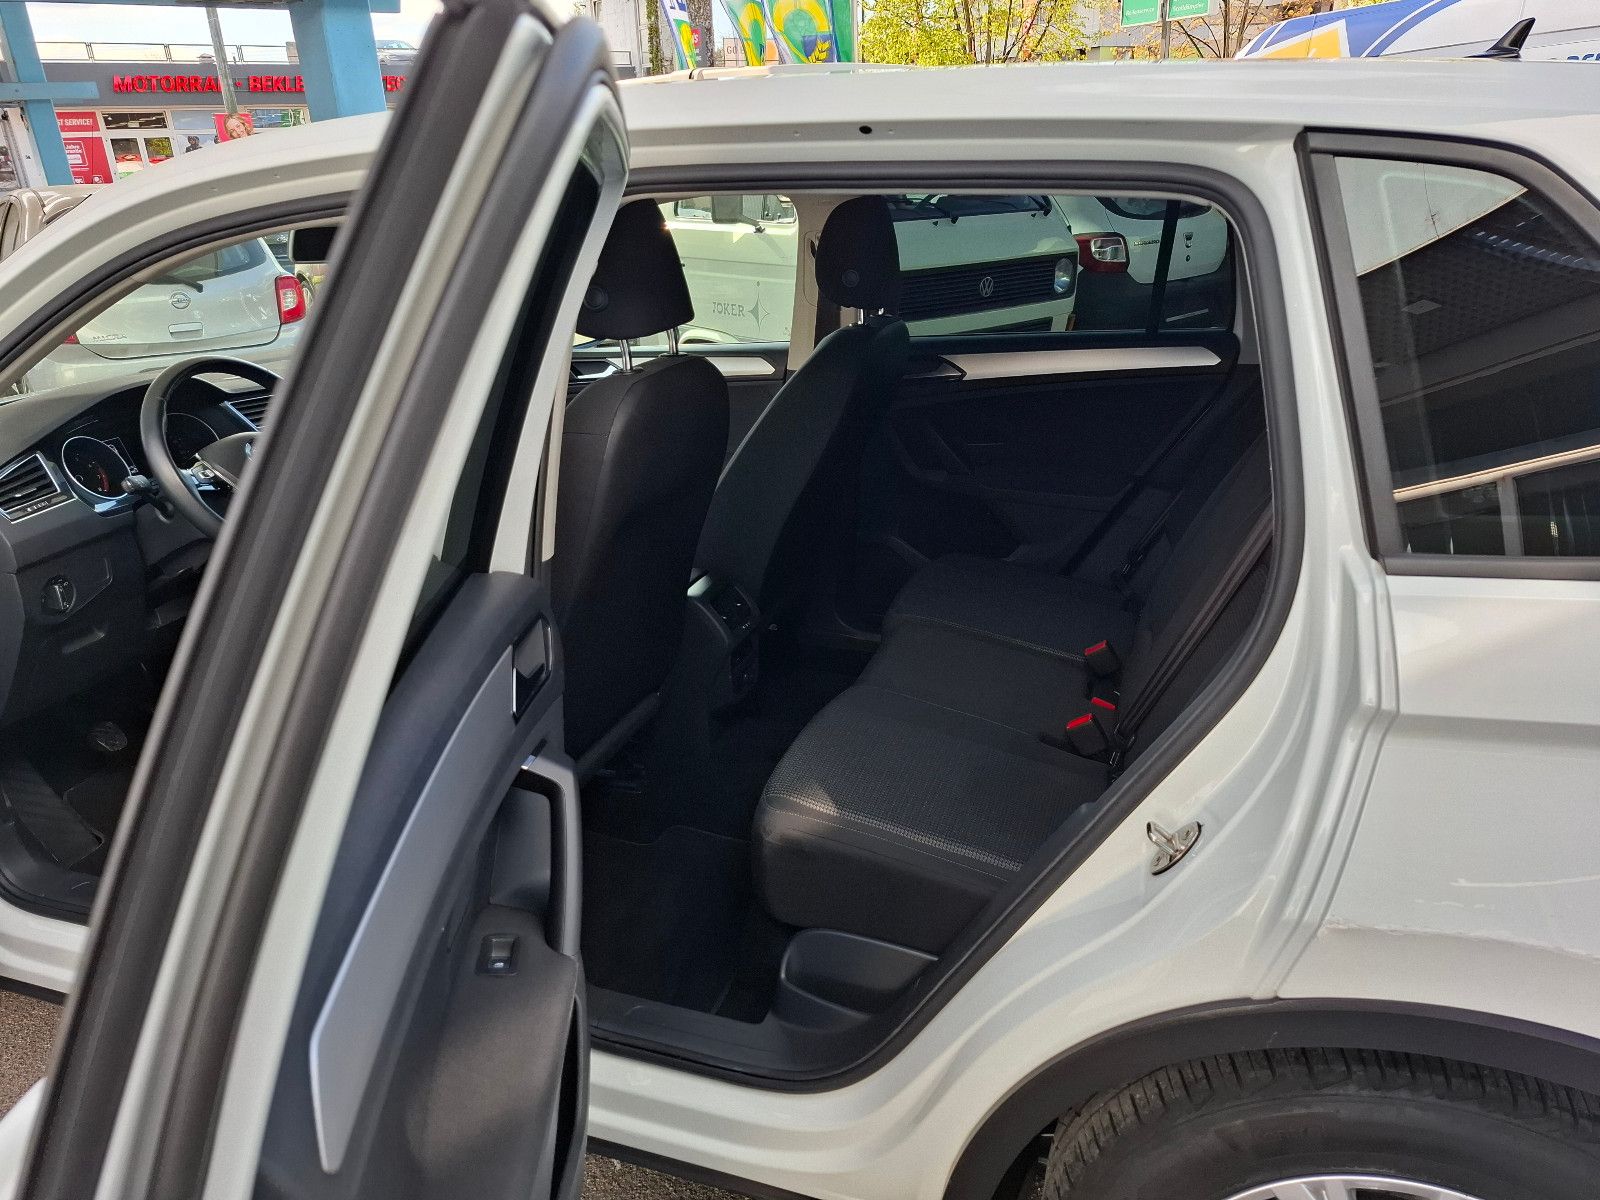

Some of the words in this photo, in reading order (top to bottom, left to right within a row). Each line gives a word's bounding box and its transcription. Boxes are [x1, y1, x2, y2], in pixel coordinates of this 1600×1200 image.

[113, 75, 222, 92] MOTORRA
[249, 75, 305, 92] BEKLE
[712, 301, 746, 317] JOKER
